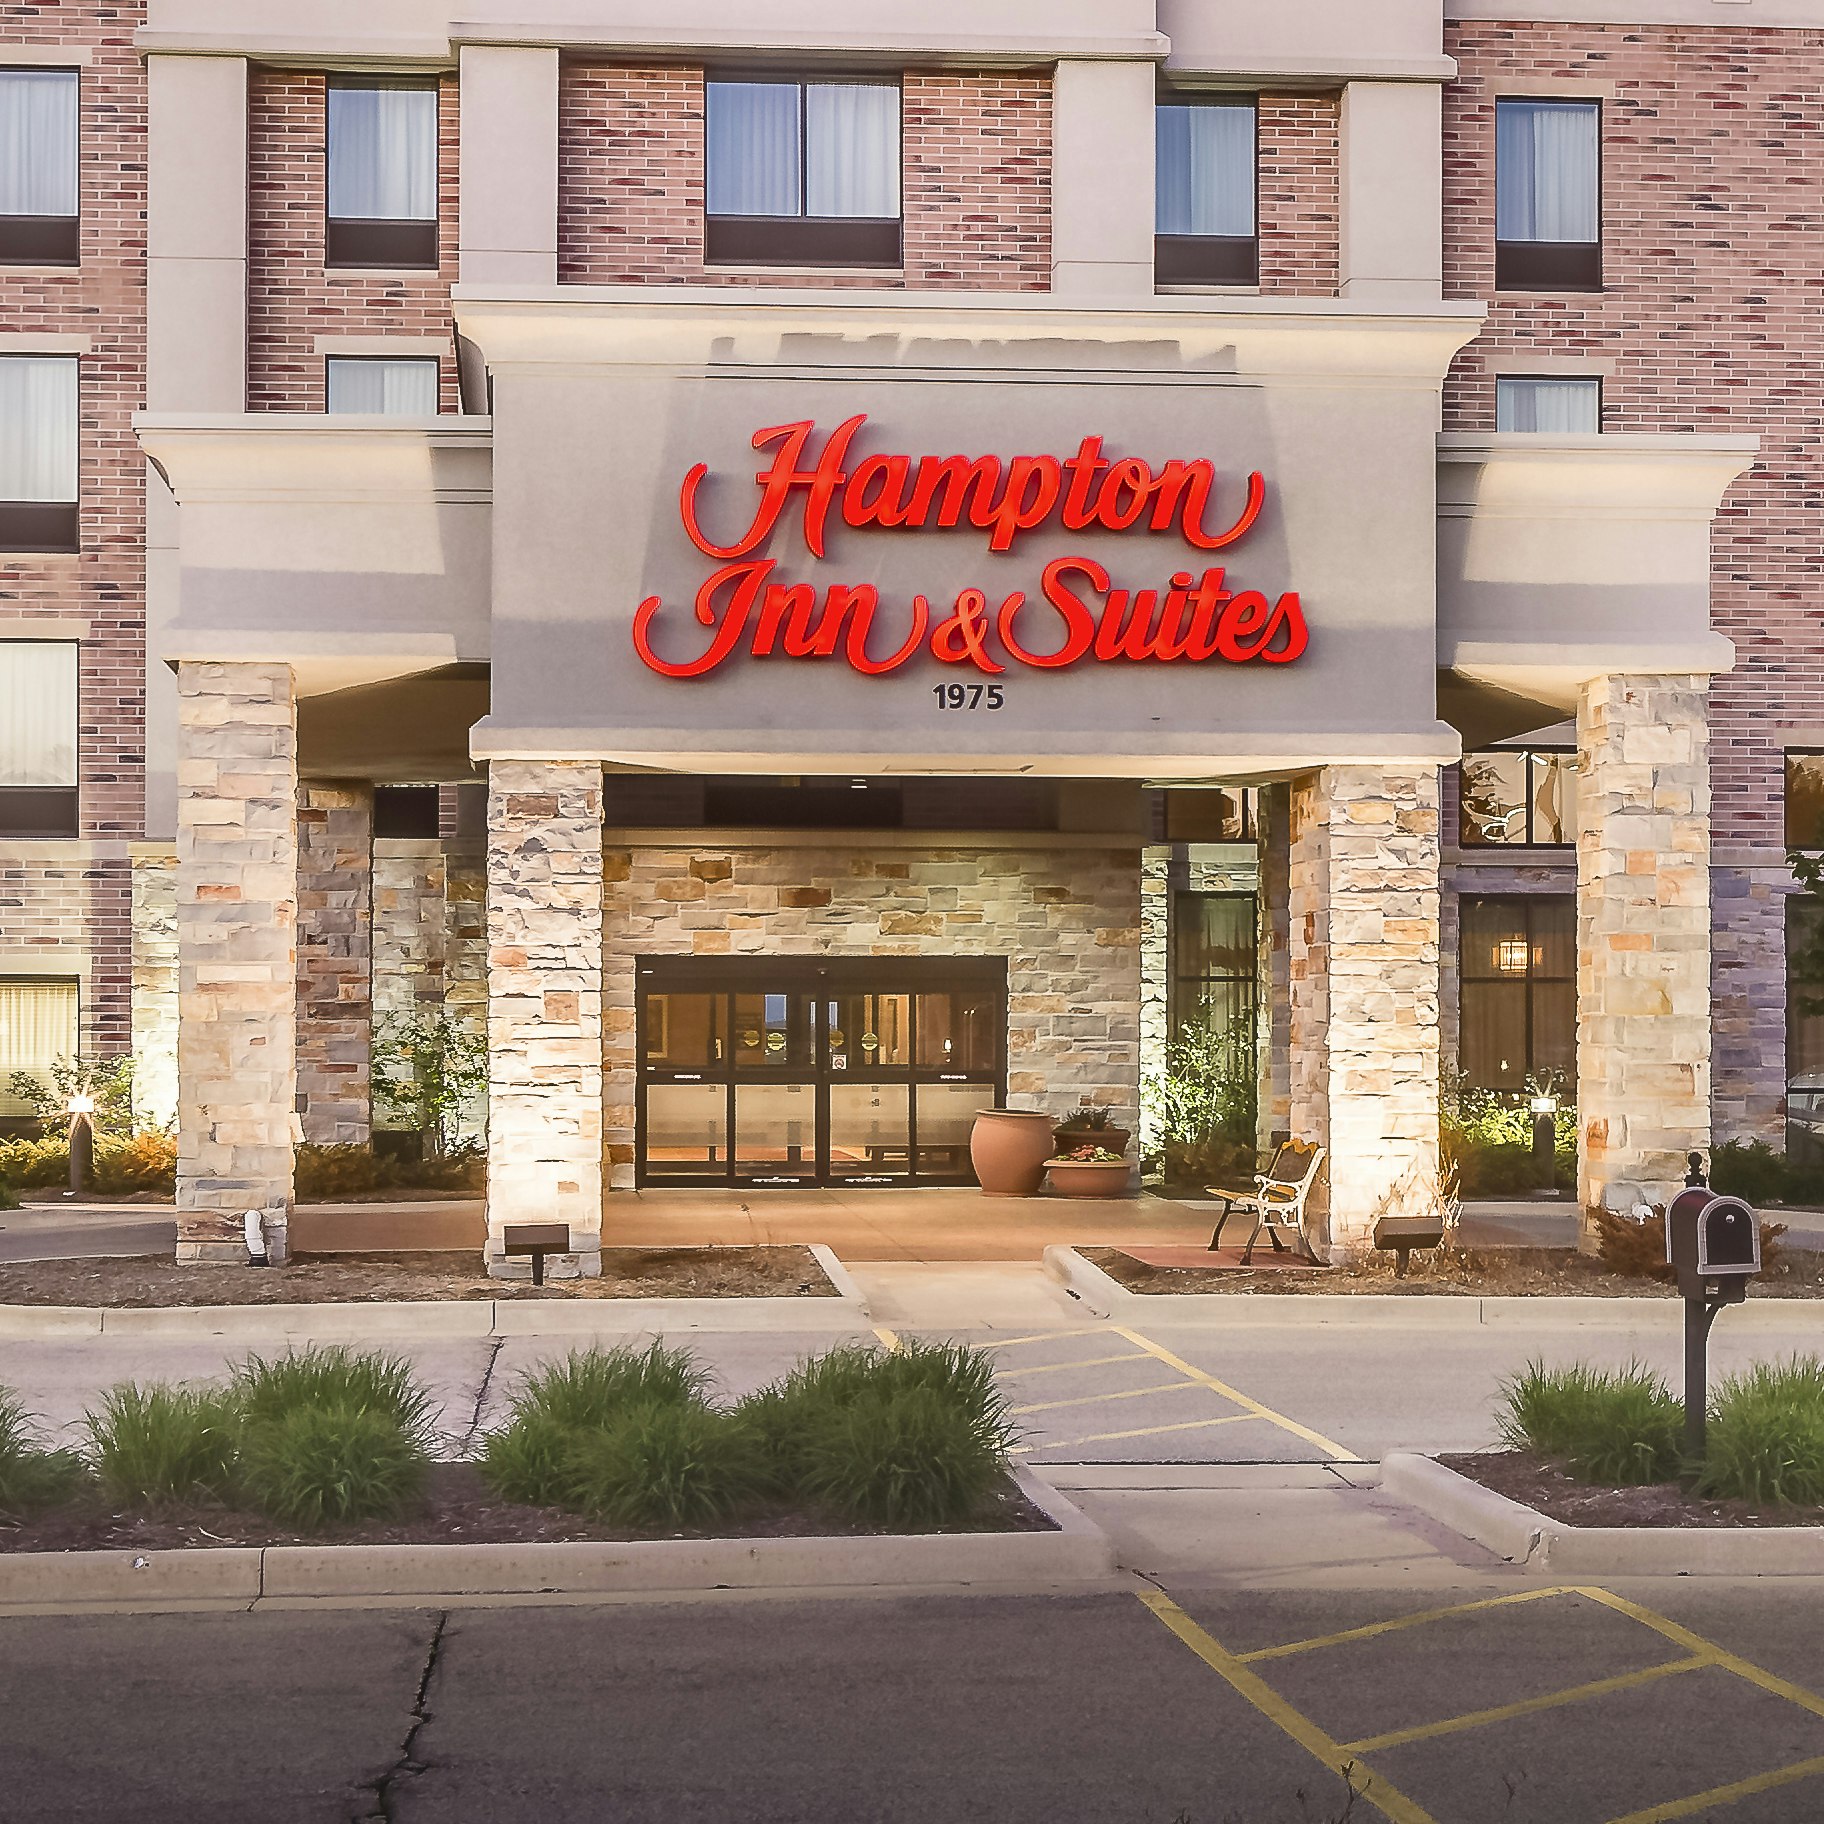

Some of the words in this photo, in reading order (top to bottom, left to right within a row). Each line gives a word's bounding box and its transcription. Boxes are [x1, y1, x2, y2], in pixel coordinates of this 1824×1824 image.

[680, 414, 1265, 558] Hampton
[632, 558, 929, 676] Inn
[930, 588, 1006, 673] &
[997, 556, 1310, 668] Suites
[932, 683, 1005, 711] 1975
